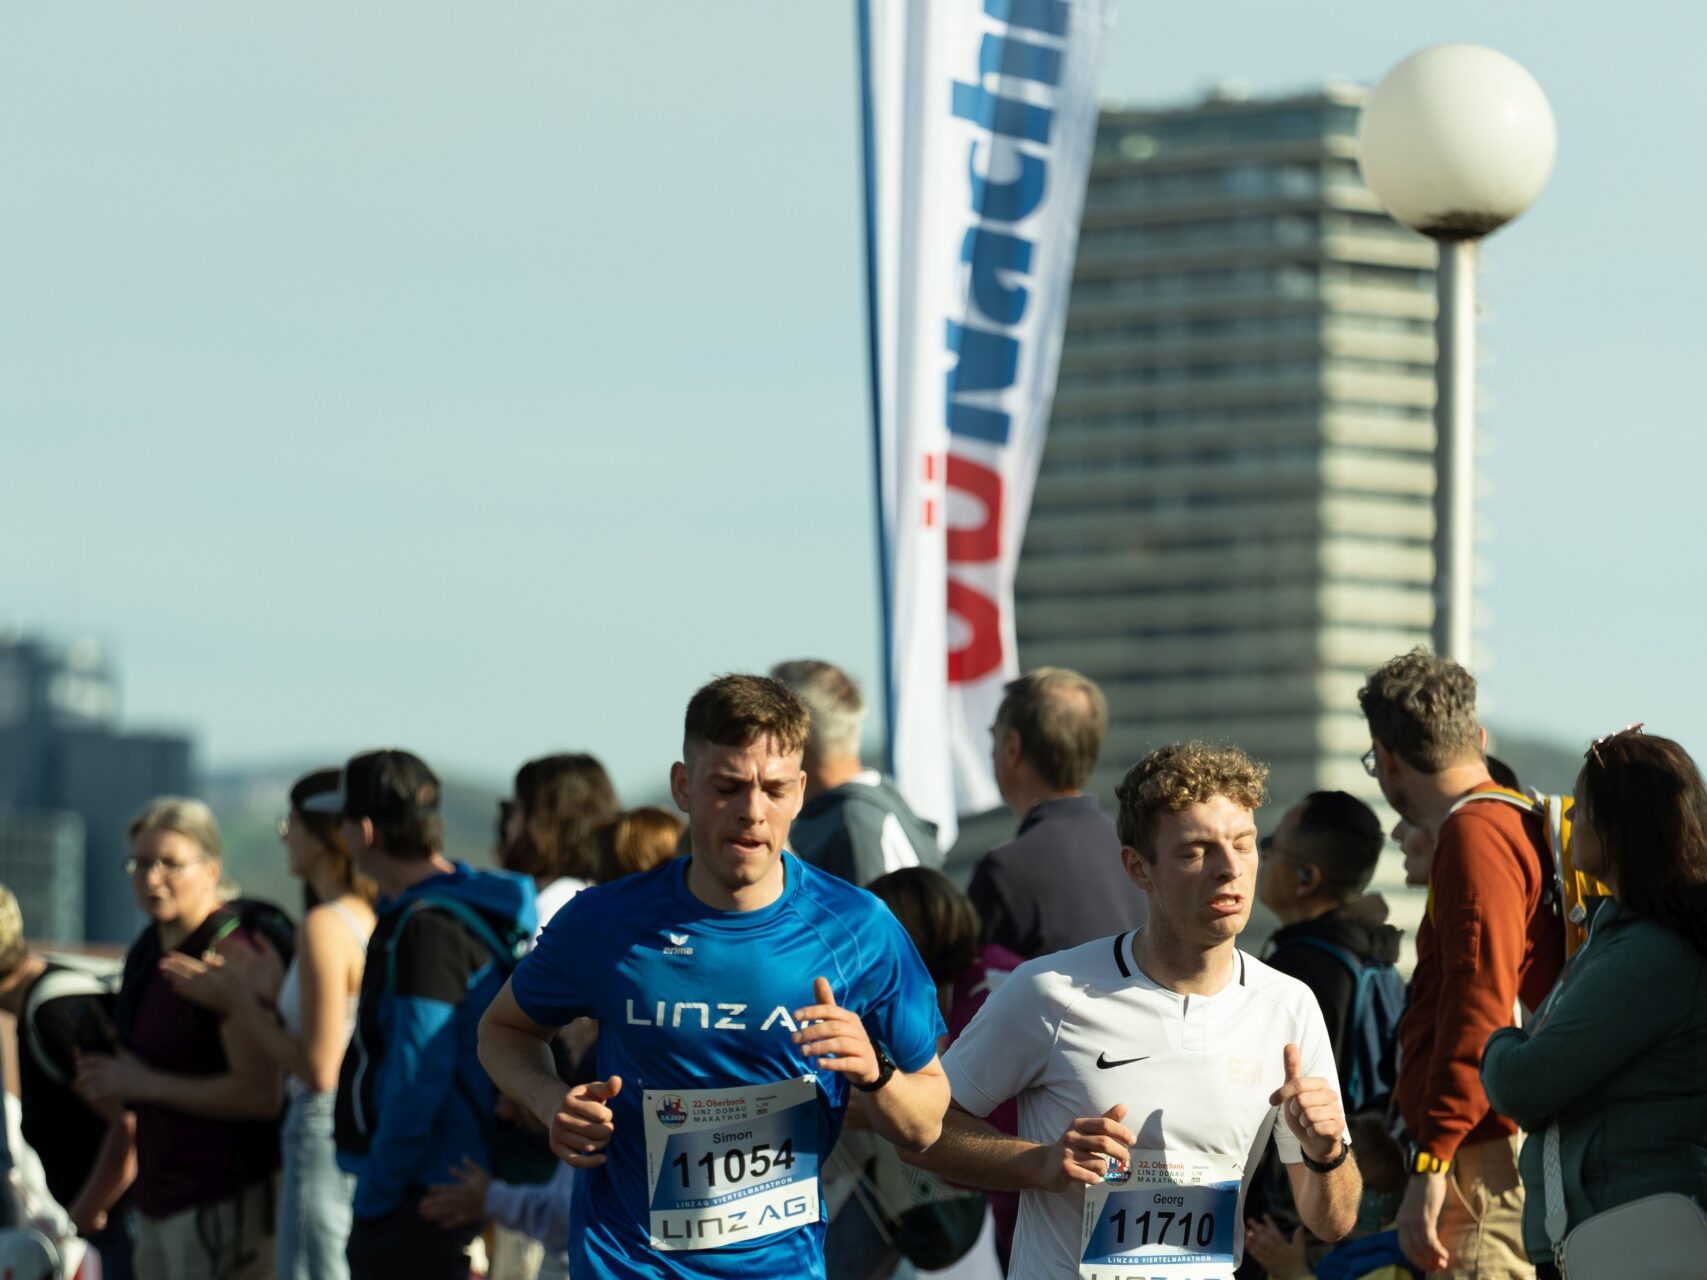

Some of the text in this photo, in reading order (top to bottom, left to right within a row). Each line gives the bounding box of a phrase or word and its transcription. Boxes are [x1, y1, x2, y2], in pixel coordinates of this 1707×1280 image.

[663, 946, 693, 955] erima
[626, 999, 824, 1032] LINZ A
[692, 1100, 705, 1108] 22.
[706, 1097, 746, 1108] Oberbank
[693, 1107, 712, 1116] LINZ
[715, 1106, 748, 1115] DONAU
[693, 1113, 748, 1123] MARATHON
[713, 1130, 752, 1144] Simon
[672, 1138, 795, 1188] 11054
[1138, 1160, 1150, 1168] 22.
[1152, 1160, 1185, 1170] Oberbank
[713, 1177, 793, 1205] VIERTELMARATHON
[1153, 1193, 1184, 1208] Georg
[662, 1196, 807, 1239] LINZ AG
[1109, 1208, 1215, 1247] 11710
[1142, 1255, 1212, 1264] VIERTELMARATHON
